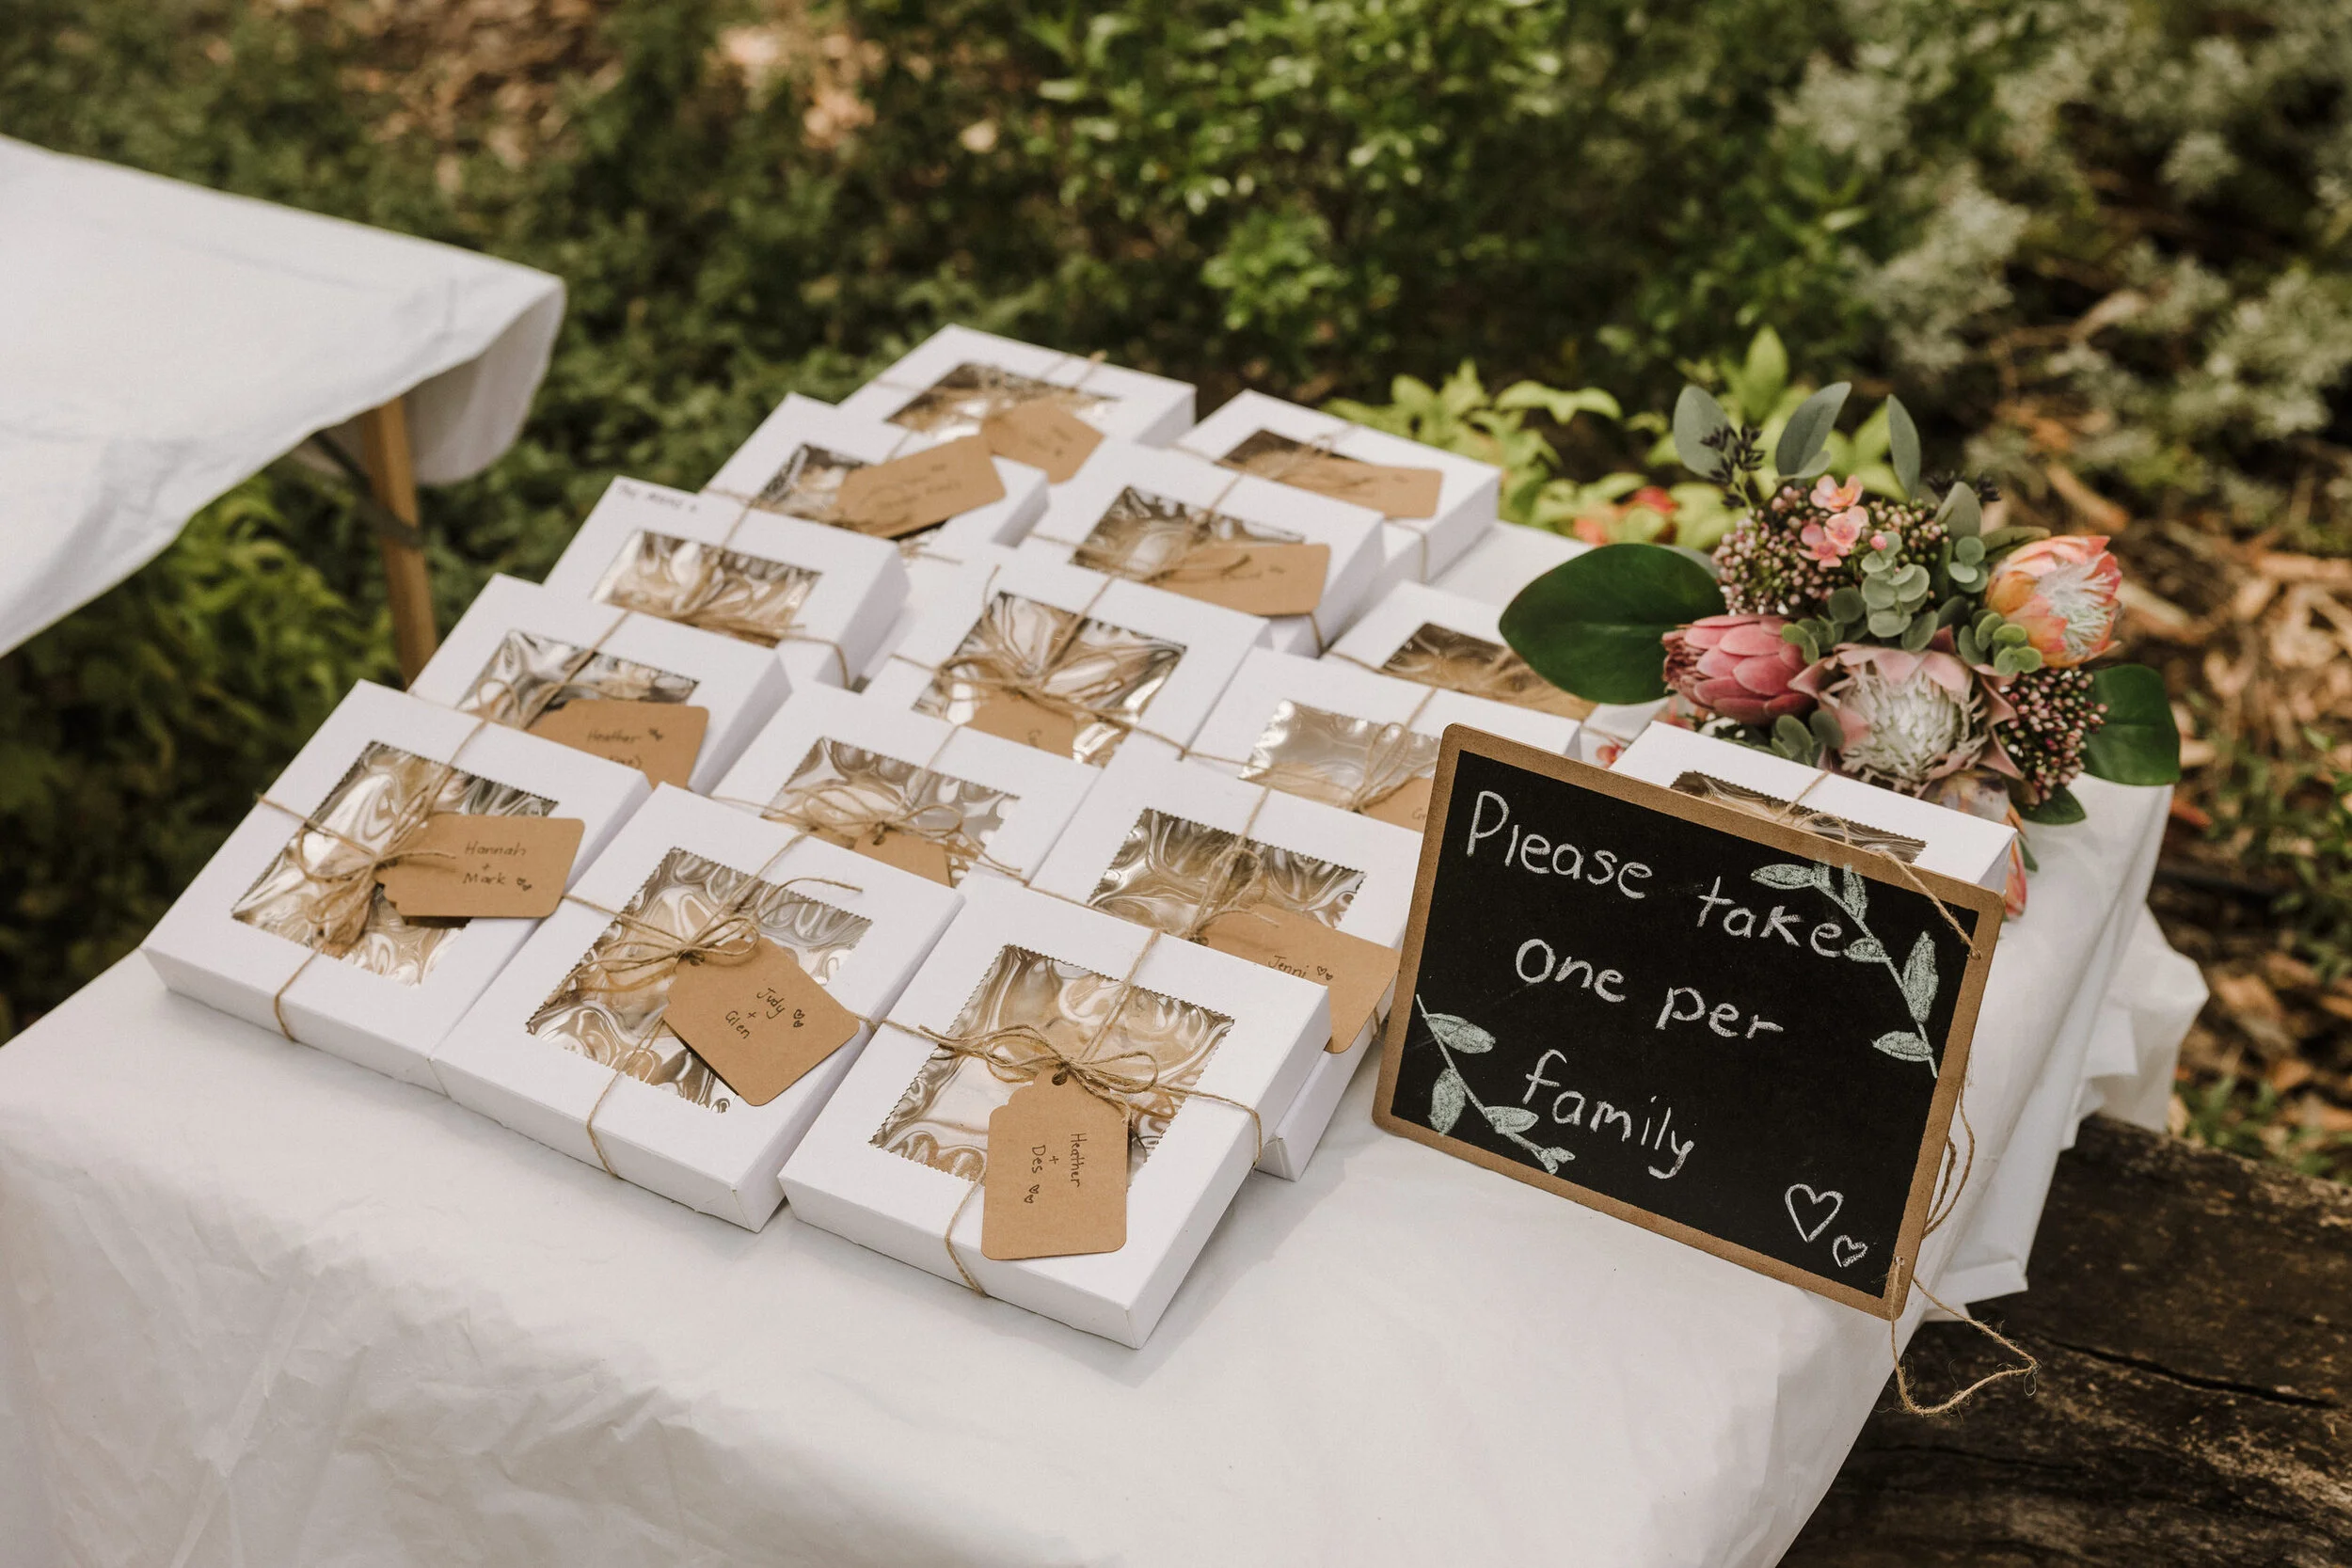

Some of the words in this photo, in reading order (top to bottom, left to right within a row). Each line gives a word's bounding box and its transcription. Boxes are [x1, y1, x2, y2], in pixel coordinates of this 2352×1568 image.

[465, 840, 527, 857] Hannah
[463, 872, 506, 886] Mark
[1467, 790, 1653, 900] Please
[1696, 875, 1846, 958] take
[756, 987, 789, 1020] Judy
[1656, 987, 1784, 1039] per
[724, 1010, 752, 1039] Glen
[1522, 1049, 1693, 1180] family
[1031, 1144, 1046, 1175] Des
[1070, 1132, 1088, 1188] Heather
